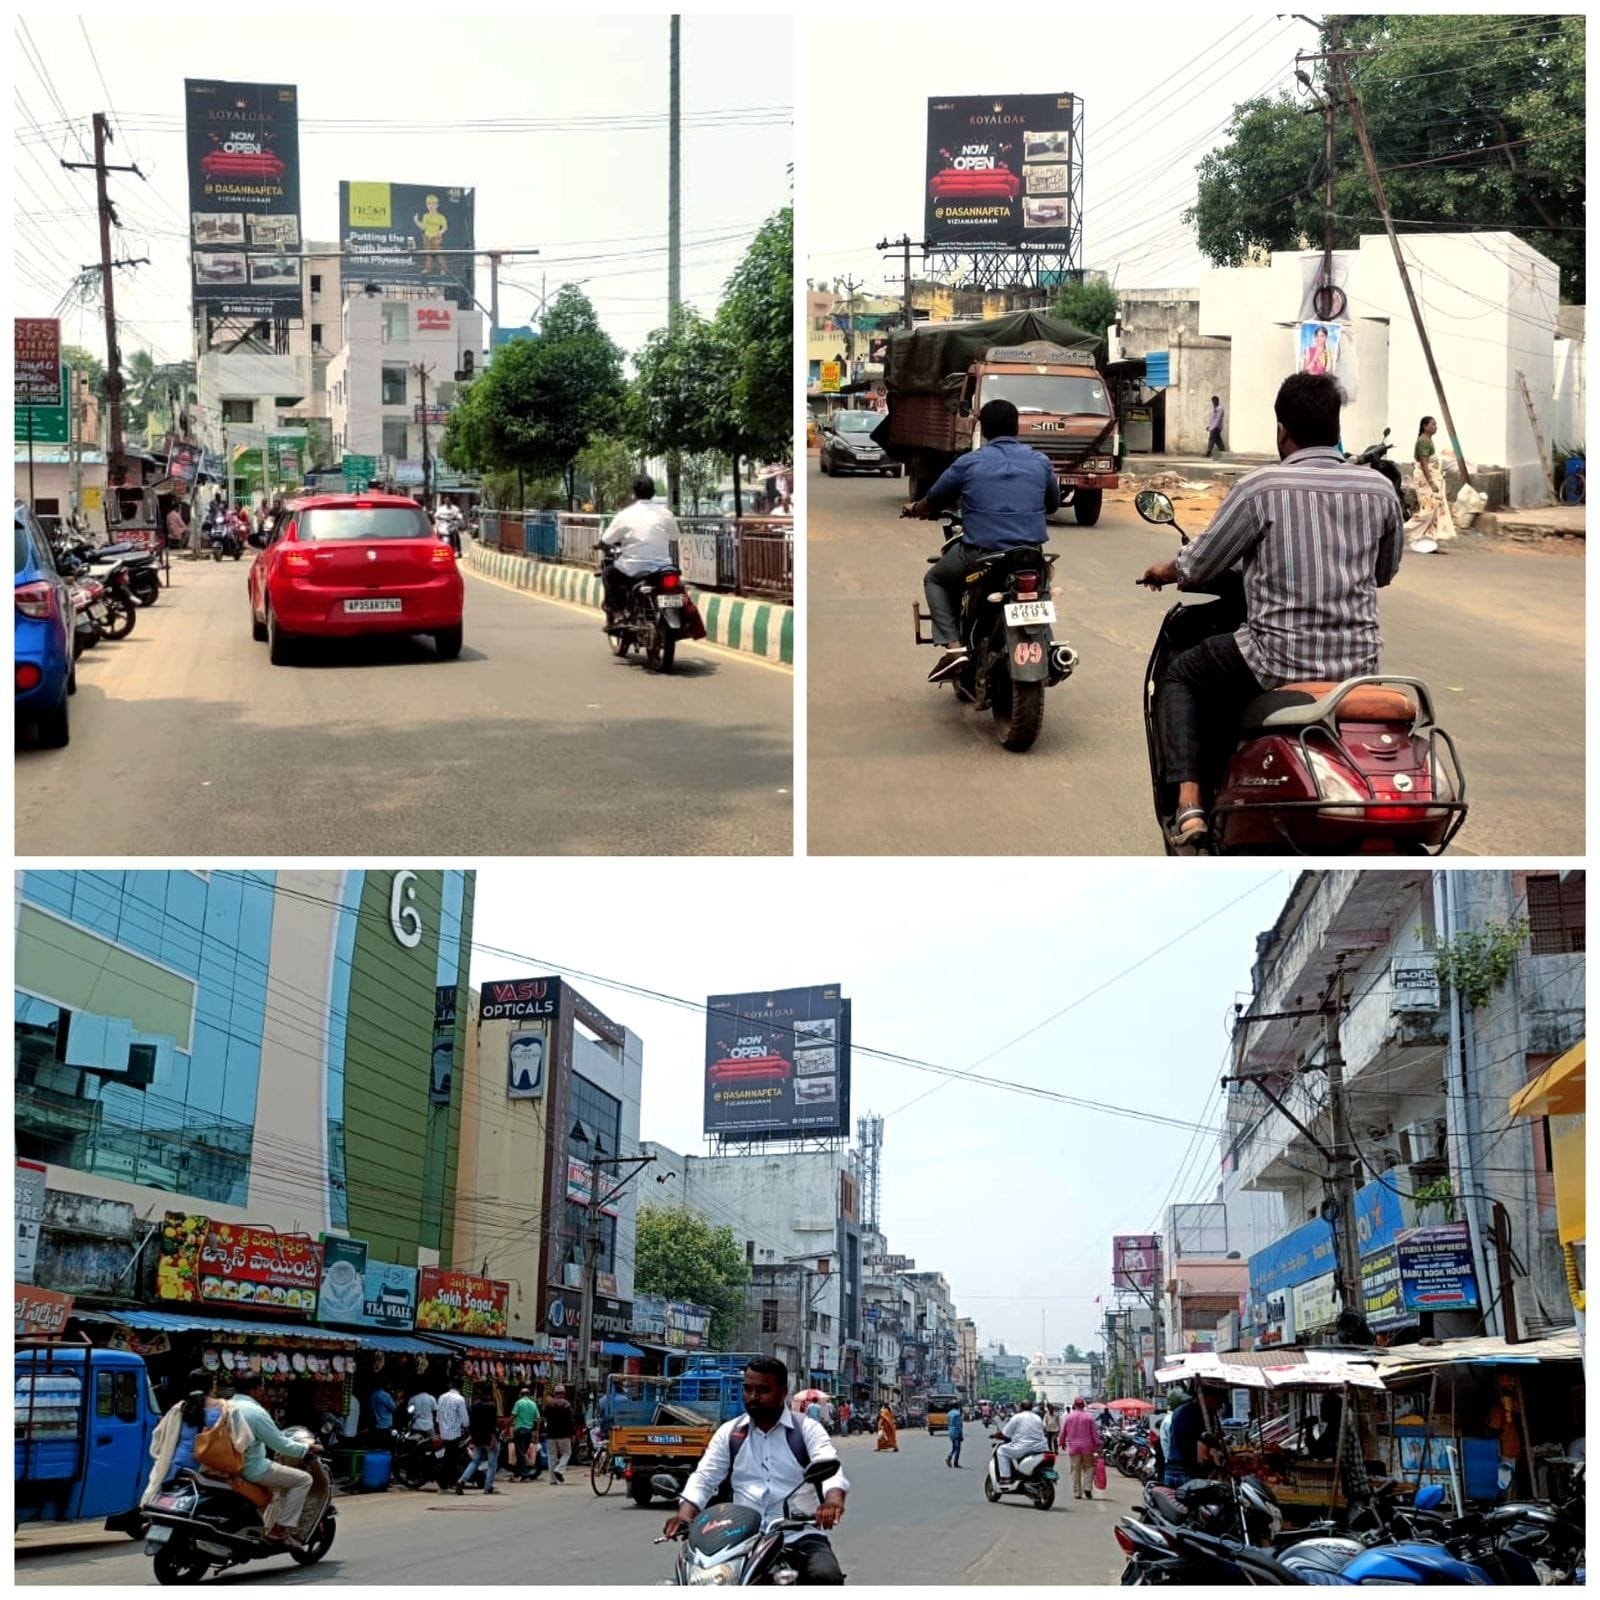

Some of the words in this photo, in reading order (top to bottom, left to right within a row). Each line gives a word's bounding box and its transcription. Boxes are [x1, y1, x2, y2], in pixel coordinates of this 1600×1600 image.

[969, 115, 1026, 125] ROYALOAK
[230, 131, 255, 141] NOW
[223, 142, 262, 154] OPEN
[962, 144, 989, 155] NOW
[953, 156, 994, 170] OPEN
[215, 184, 284, 195] DASANNAPETA
[935, 207, 943, 218] @
[945, 206, 1011, 217] DASANNAPETA
[947, 217, 998, 225] VIZIANAGARAM
[493, 981, 548, 1001] VASU
[483, 1000, 554, 1017] OPTICALS
[738, 1036, 762, 1046] NOW
[730, 1046, 768, 1060] OPEN
[723, 1088, 783, 1100] DASANNAPETA
[1424, 1267, 1446, 1277] BOOK
[1446, 1263, 1473, 1276] HOUSE
[438, 1288, 462, 1306] Sukh
[464, 1293, 493, 1313] Sagar
[366, 1302, 384, 1316] TEA
[386, 1304, 412, 1318] STALL
